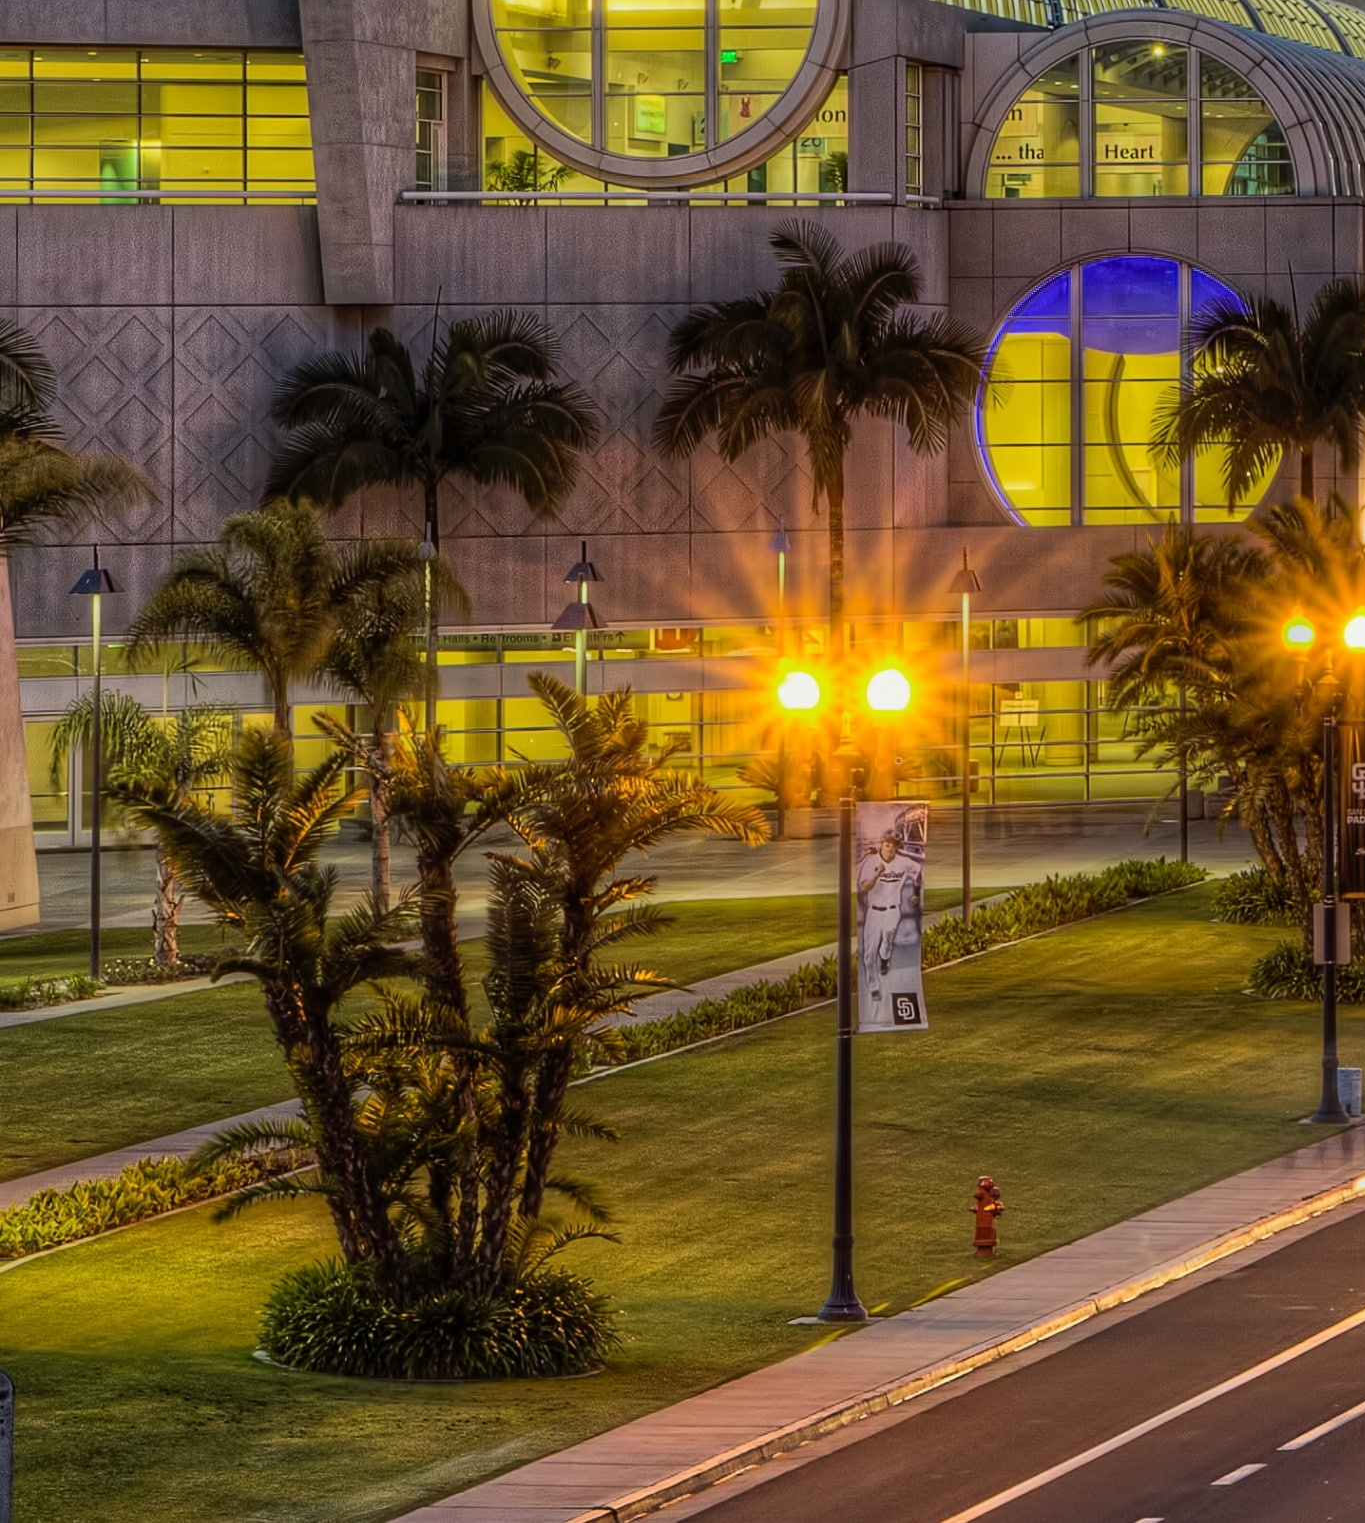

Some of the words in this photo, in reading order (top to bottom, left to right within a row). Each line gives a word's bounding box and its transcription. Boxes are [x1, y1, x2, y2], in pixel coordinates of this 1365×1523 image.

[1104, 144, 1154, 160] Heart
[481, 633, 539, 644] Retrooms
[897, 997, 915, 1020] SD
